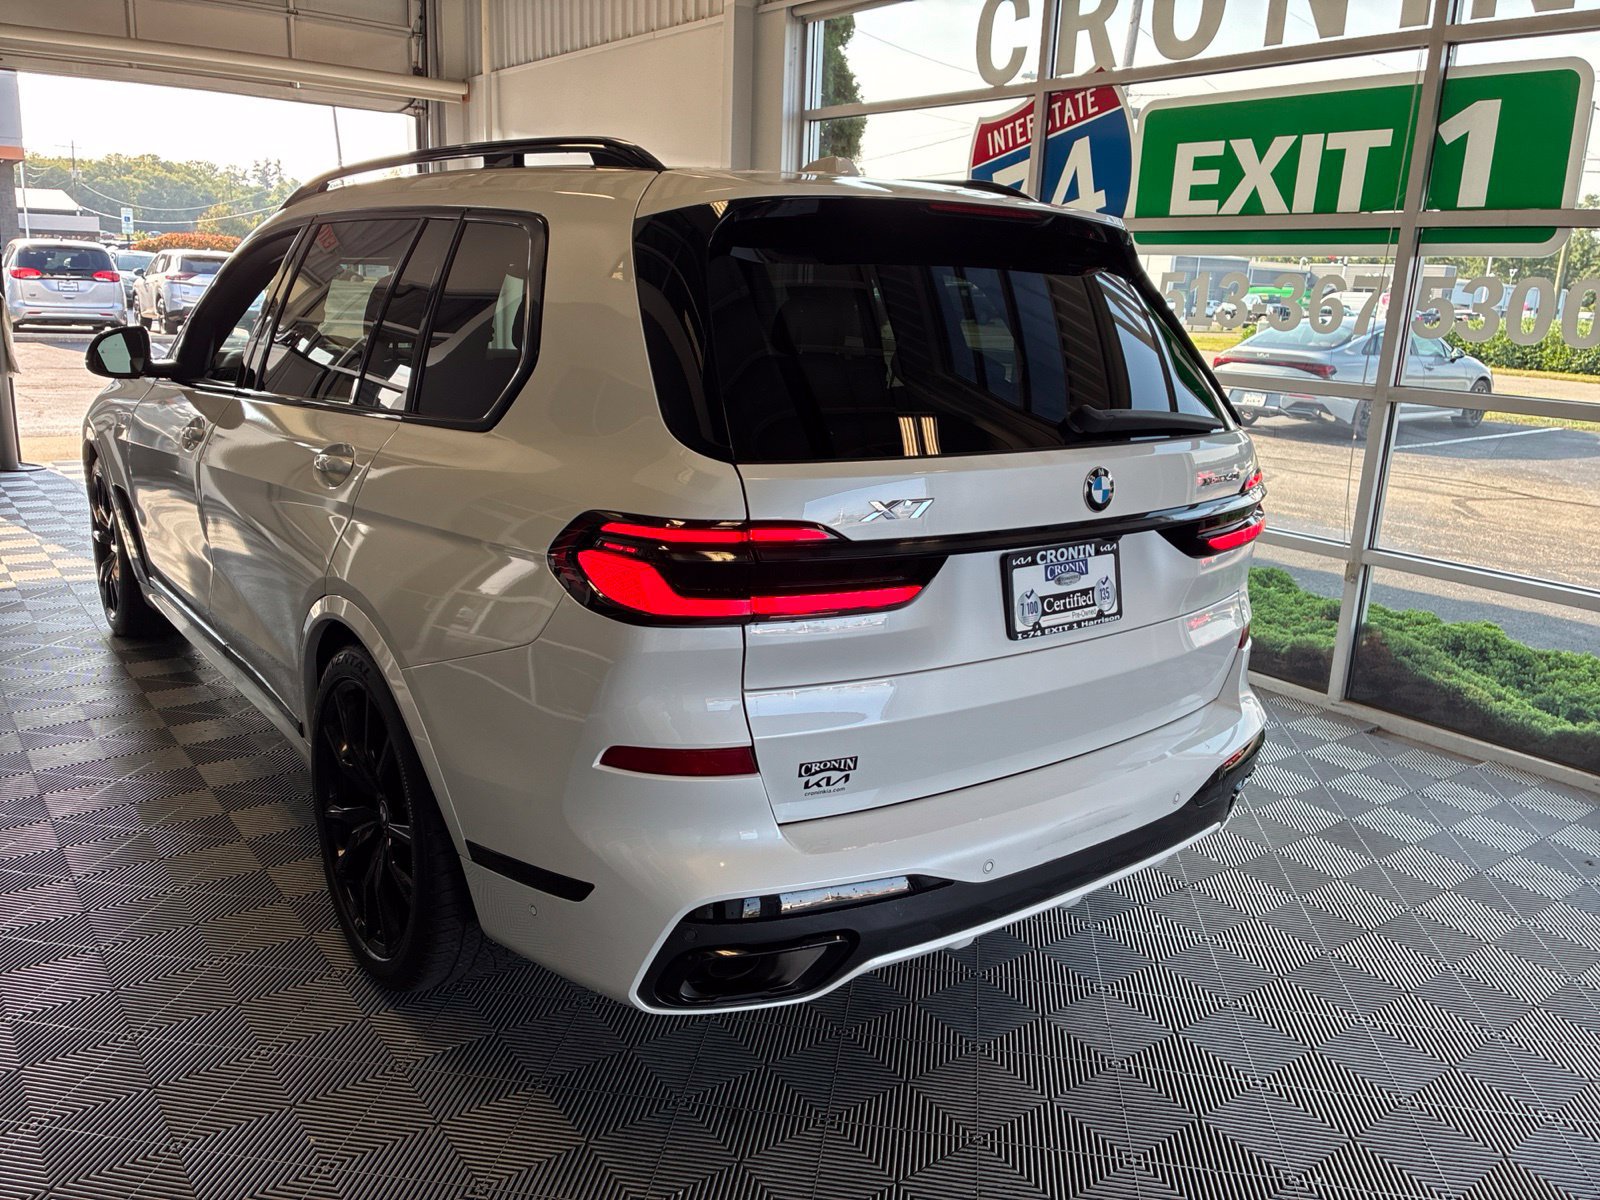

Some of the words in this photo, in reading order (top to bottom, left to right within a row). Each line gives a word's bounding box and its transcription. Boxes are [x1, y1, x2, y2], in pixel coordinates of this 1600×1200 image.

[987, 88, 1099, 156] INTERTATE
[1168, 128, 1394, 216] EXIT
[1438, 99, 1502, 208] 1
[859, 497, 935, 522] X7
[1036, 543, 1095, 565] CRONIN
[1047, 560, 1087, 580] CRONIN
[1043, 590, 1094, 613] Certified
[1072, 608, 1097, 620] Pre-Owned
[1017, 630, 1042, 640] I-74
[1045, 624, 1070, 635] EXIT
[1081, 614, 1121, 628] Harrison
[800, 757, 856, 777] CRONIN
[803, 773, 851, 790] KIA
[804, 787, 846, 797] croninkia.com
